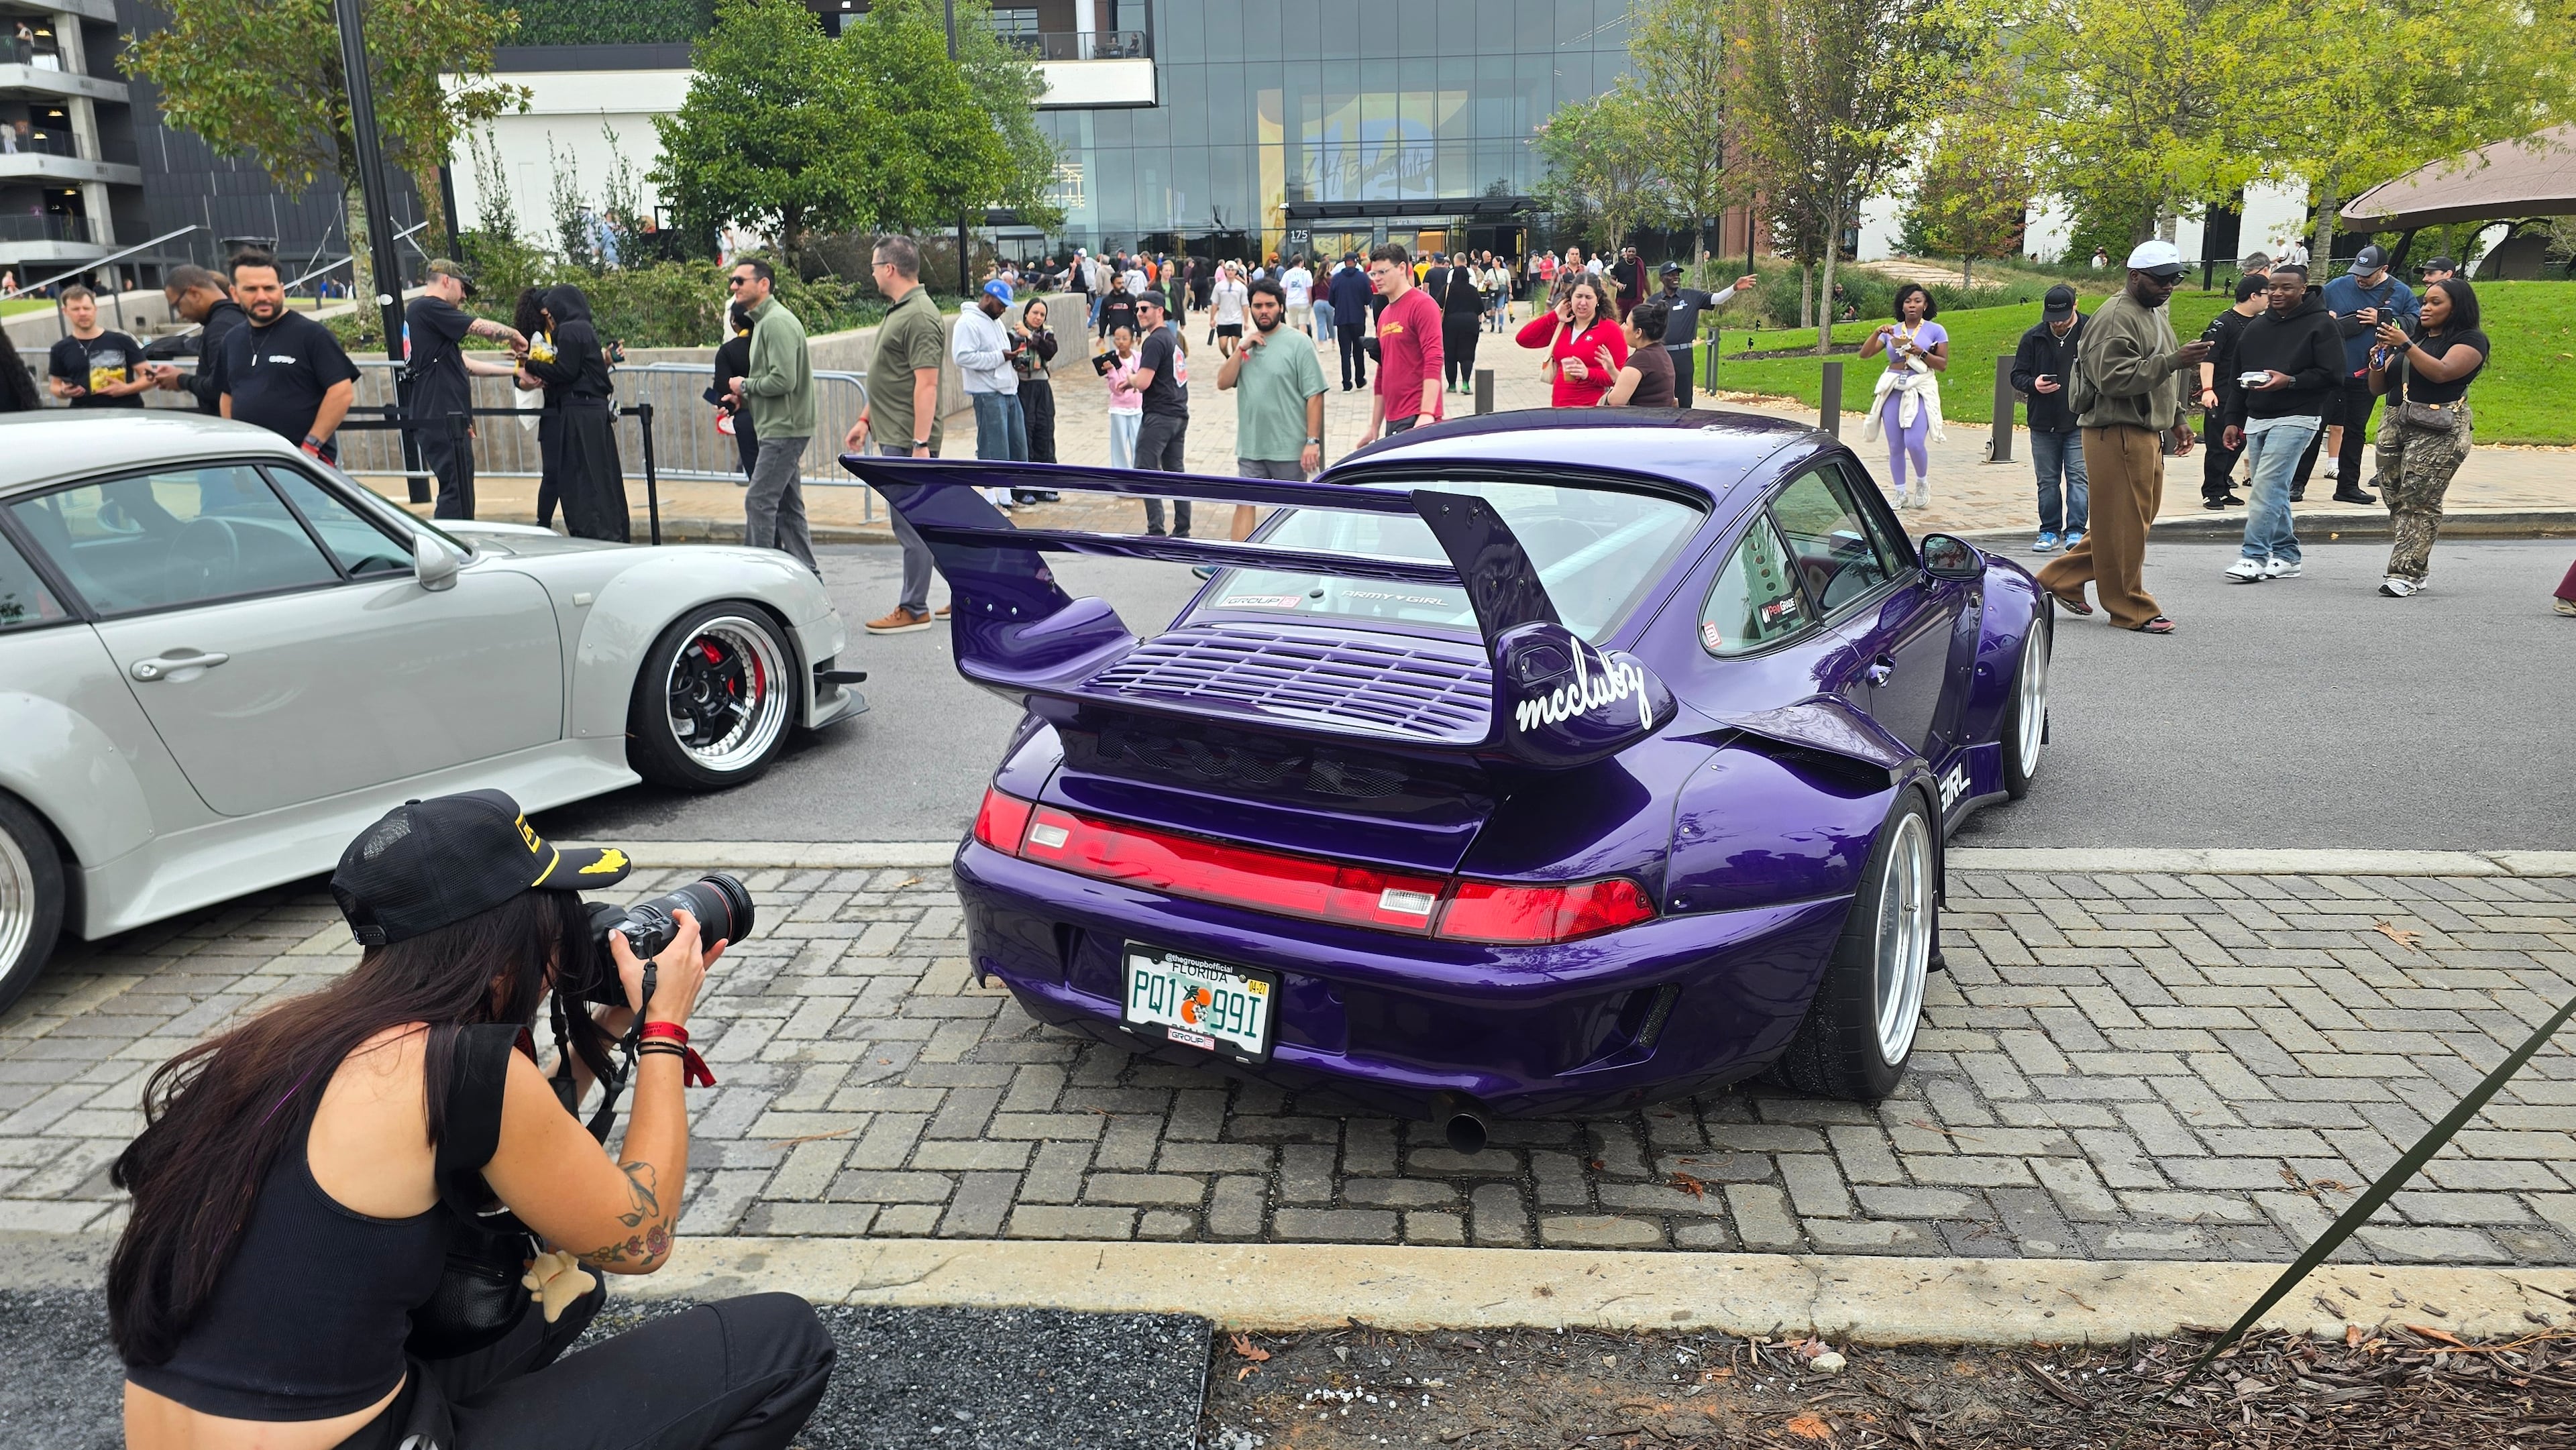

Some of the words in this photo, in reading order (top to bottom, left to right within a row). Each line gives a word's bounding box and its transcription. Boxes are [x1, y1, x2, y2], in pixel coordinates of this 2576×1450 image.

[1291, 230, 1307, 239] 175
[1342, 590, 1395, 600] ARMY
[1406, 596, 1448, 606] GIRL
[1165, 953, 1233, 973] @thegroupbofficial
[1173, 962, 1228, 984] FLORIDA
[1133, 970, 1176, 1017] PQ1
[1171, 1031, 1204, 1044] GROUP
